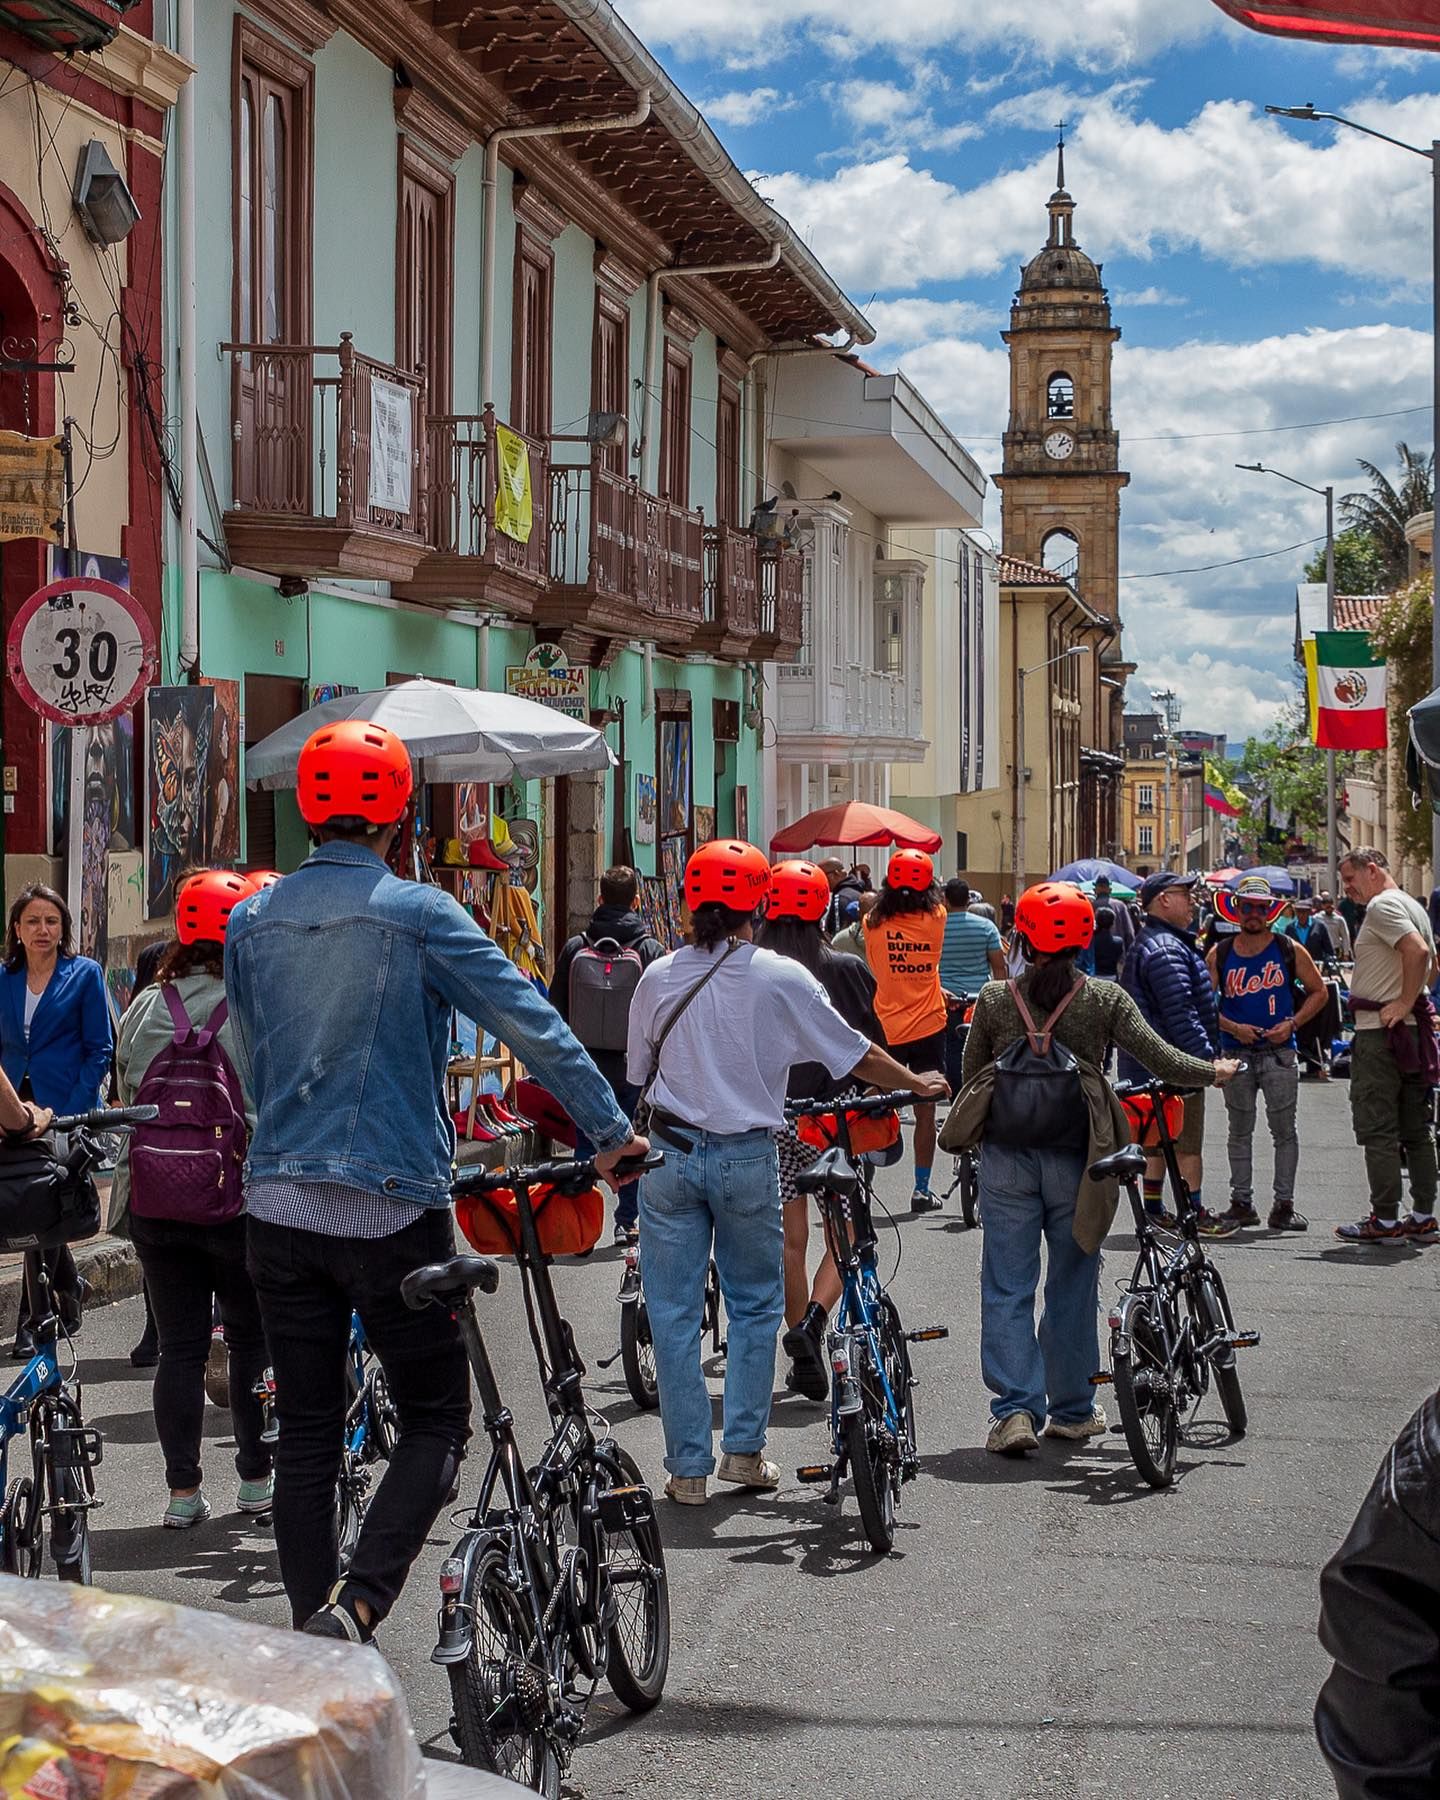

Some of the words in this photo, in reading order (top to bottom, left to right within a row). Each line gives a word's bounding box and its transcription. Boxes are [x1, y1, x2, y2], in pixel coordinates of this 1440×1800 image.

[53, 628, 118, 682] 30
[508, 668, 584, 686] COLOMBIA
[887, 930, 904, 940] LA
[888, 942, 931, 952] BUENA
[889, 953, 907, 962] PA'
[890, 963, 932, 973] TODOS
[1225, 961, 1284, 998] Mets
[1269, 994, 1276, 1016] 1
